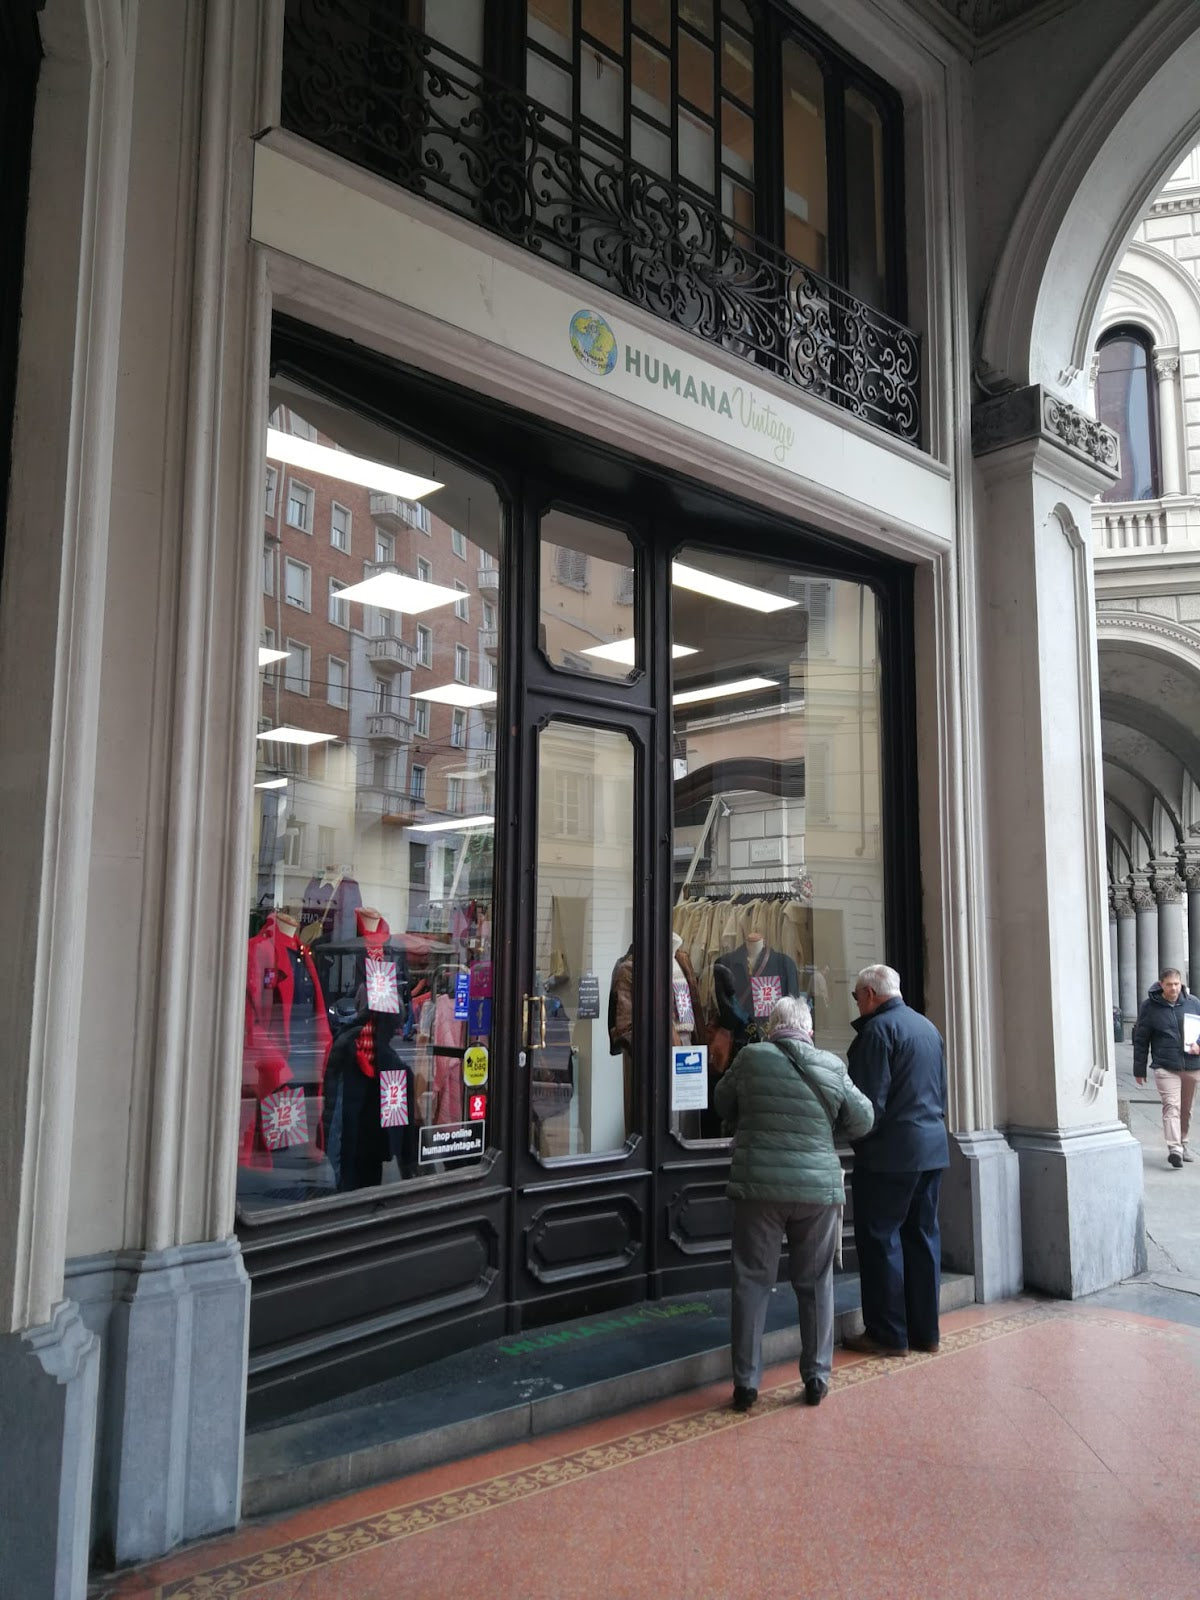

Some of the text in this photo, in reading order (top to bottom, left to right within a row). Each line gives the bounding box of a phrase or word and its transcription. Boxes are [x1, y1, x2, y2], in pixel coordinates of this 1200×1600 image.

[625, 345, 795, 462] HUMANA Vintage
[762, 987, 772, 997] 12
[390, 1086, 399, 1098] 12
[277, 1104, 291, 1120] 12
[432, 1129, 473, 1143] shop online
[422, 1139, 481, 1155] humanavintage.it
